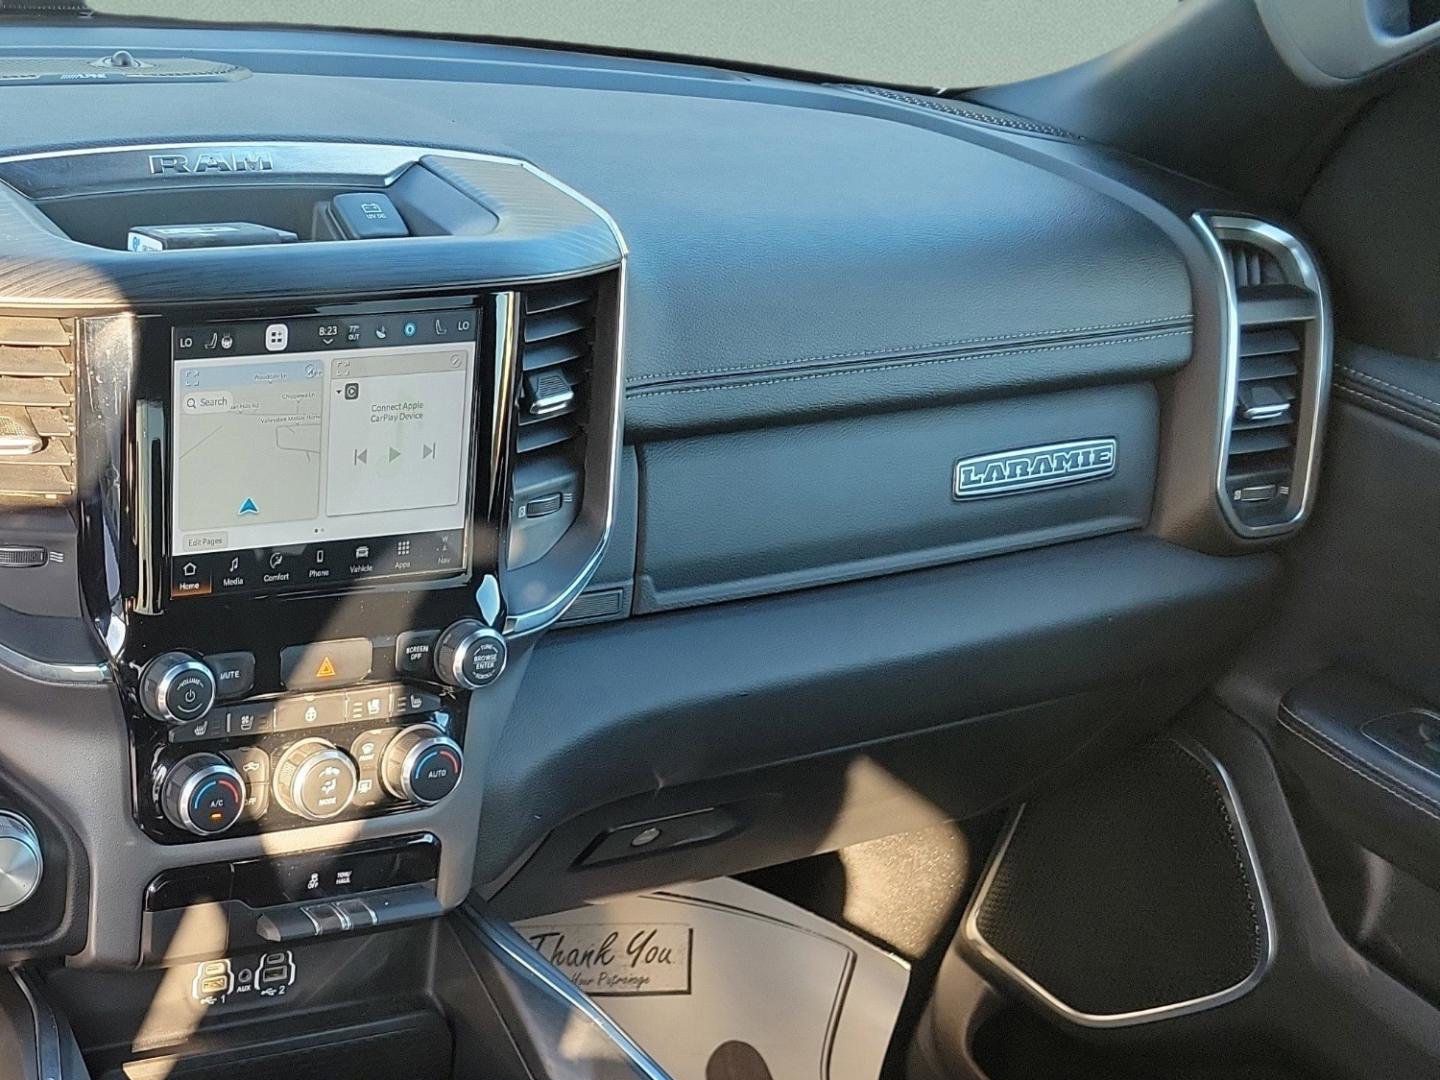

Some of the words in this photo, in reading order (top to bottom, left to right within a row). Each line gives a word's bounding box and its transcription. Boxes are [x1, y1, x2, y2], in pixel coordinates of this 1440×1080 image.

[148, 152, 273, 174] RAM
[319, 325, 338, 336] 8:23
[458, 321, 470, 331] LO
[180, 337, 193, 348] LO
[200, 397, 228, 407] Search
[371, 403, 402, 413] Connect
[402, 401, 425, 411] Apple
[370, 412, 399, 424] CarPlay
[399, 412, 424, 421] Device
[959, 444, 1114, 490] LARAMIE
[188, 538, 202, 547] Edit
[203, 537, 223, 547] Pages
[437, 556, 451, 564] Nav
[349, 564, 373, 574] Vehicle
[394, 561, 411, 570] Apps
[263, 572, 290, 583] Comfort
[308, 570, 330, 578] Phone
[179, 582, 200, 590] Home
[223, 578, 244, 587] Media
[406, 645, 429, 654] SCREEN
[410, 653, 422, 661] OFF
[473, 653, 498, 662] BROWSE
[475, 661, 495, 670] ENTER
[220, 670, 240, 681] MUTE
[180, 677, 200, 687] VOLUME
[427, 769, 447, 779] AUTO
[210, 799, 224, 808] A/C
[318, 797, 337, 806] MODE
[529, 930, 619, 968] Thank
[625, 927, 673, 968] You
[236, 985, 252, 993] AUX
[278, 985, 286, 995] 2
